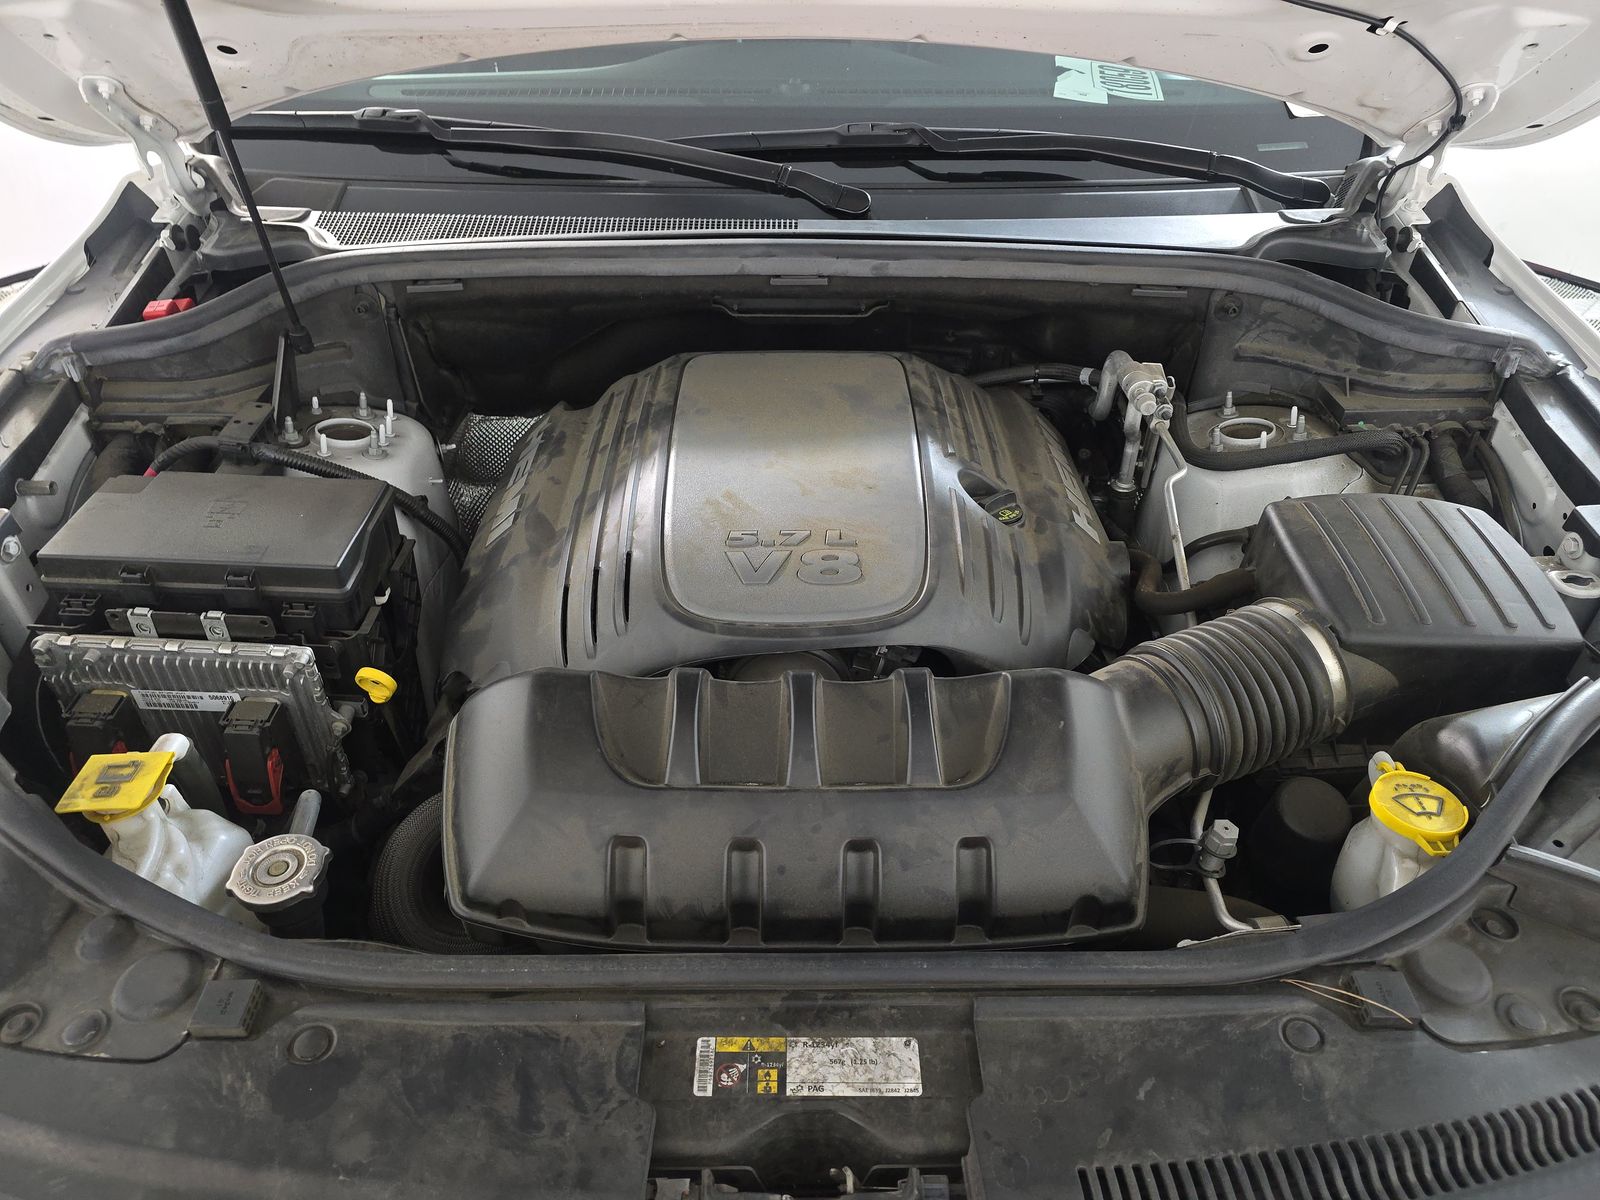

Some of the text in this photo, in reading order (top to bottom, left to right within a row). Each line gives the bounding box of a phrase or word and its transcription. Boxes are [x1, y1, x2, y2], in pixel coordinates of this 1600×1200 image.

[1098, 64, 1152, 95] 18059
[725, 529, 858, 547] 5.7 L
[724, 549, 863, 585] V8
[807, 1084, 825, 1093] PAG
